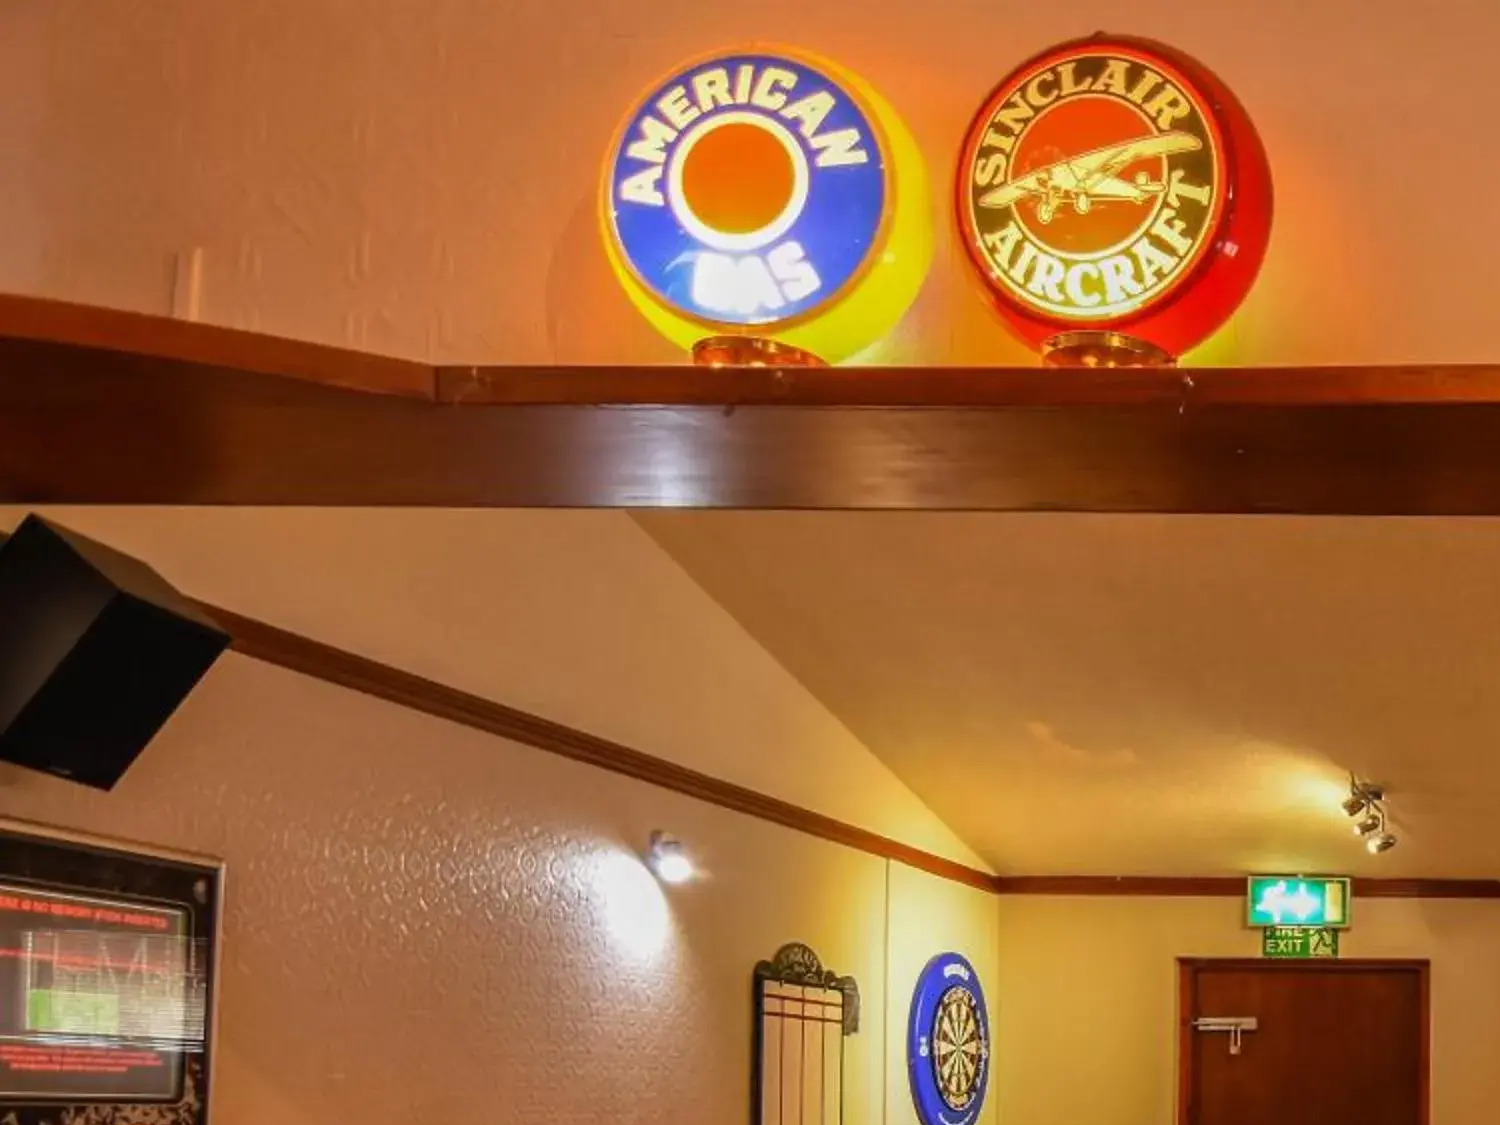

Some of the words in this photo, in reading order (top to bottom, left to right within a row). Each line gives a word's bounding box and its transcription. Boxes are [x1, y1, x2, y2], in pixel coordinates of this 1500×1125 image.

[620, 64, 869, 207] AMERICAN
[975, 60, 1193, 187] SINCLAIR
[984, 168, 1211, 309] AIRCRAFT
[1265, 939, 1304, 953] EXIT
